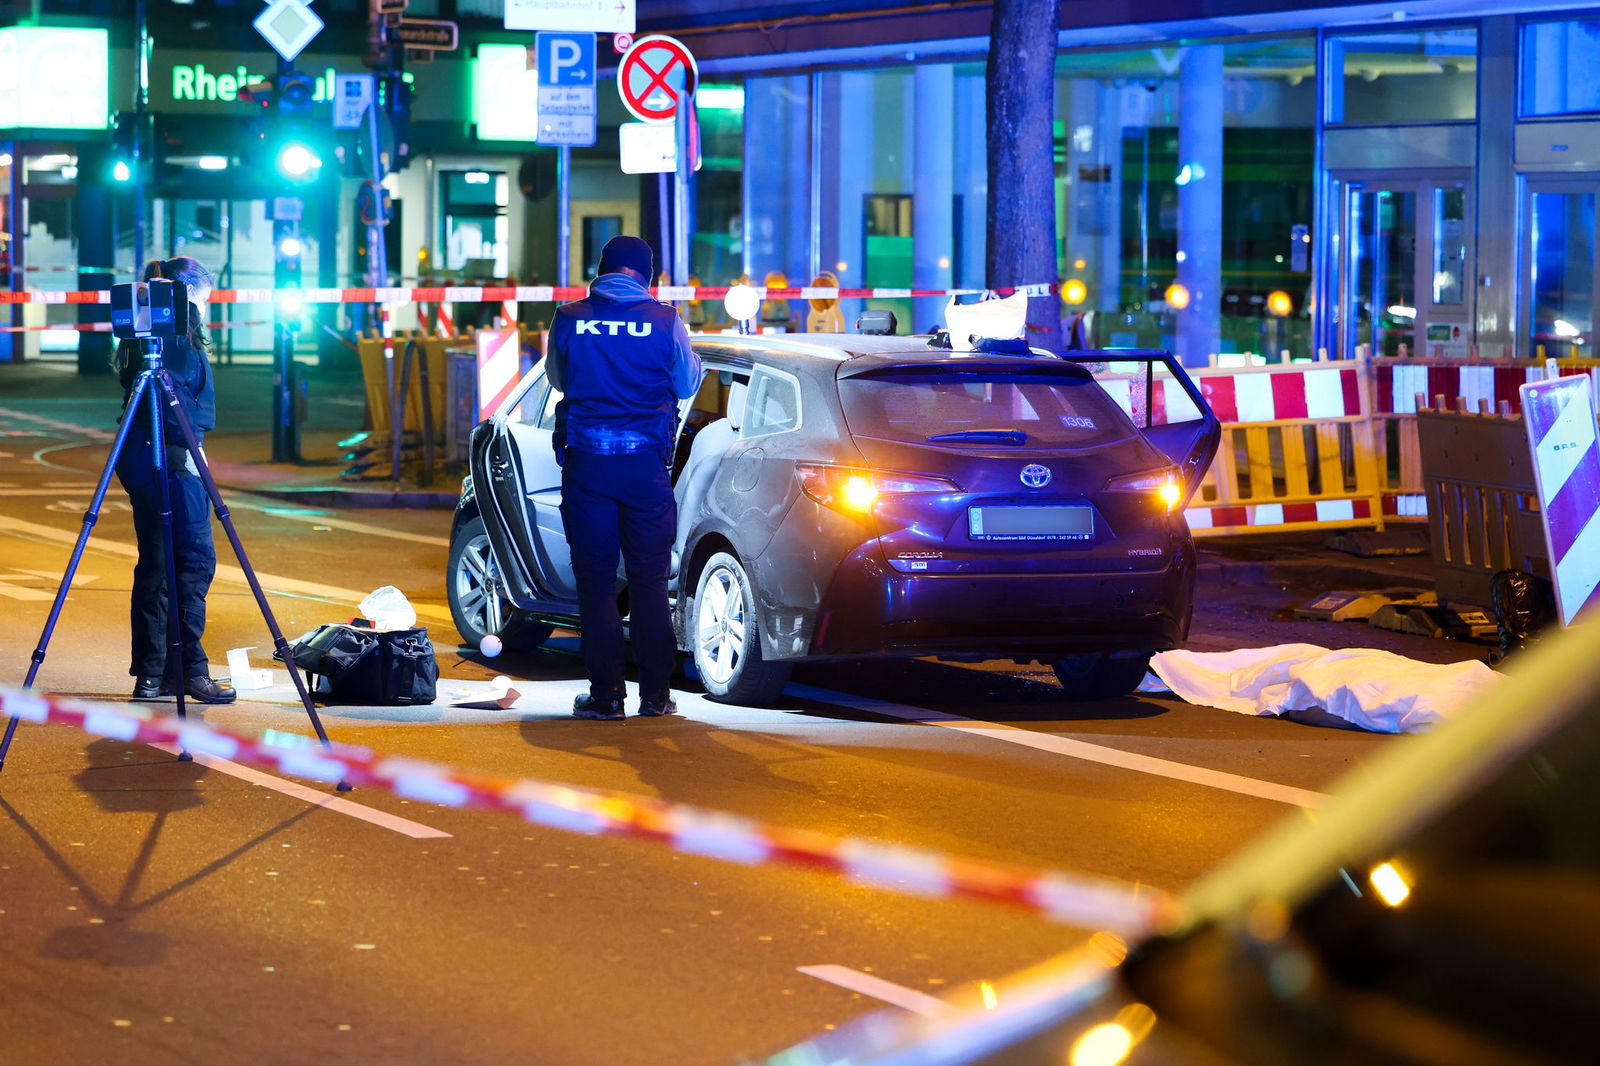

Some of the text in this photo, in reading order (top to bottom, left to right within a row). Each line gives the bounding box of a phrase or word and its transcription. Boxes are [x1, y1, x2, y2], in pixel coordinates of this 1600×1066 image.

[550, 39, 582, 84] P
[576, 320, 652, 337] KTU
[1062, 416, 1094, 428] 1306
[897, 551, 943, 559] COROLLA
